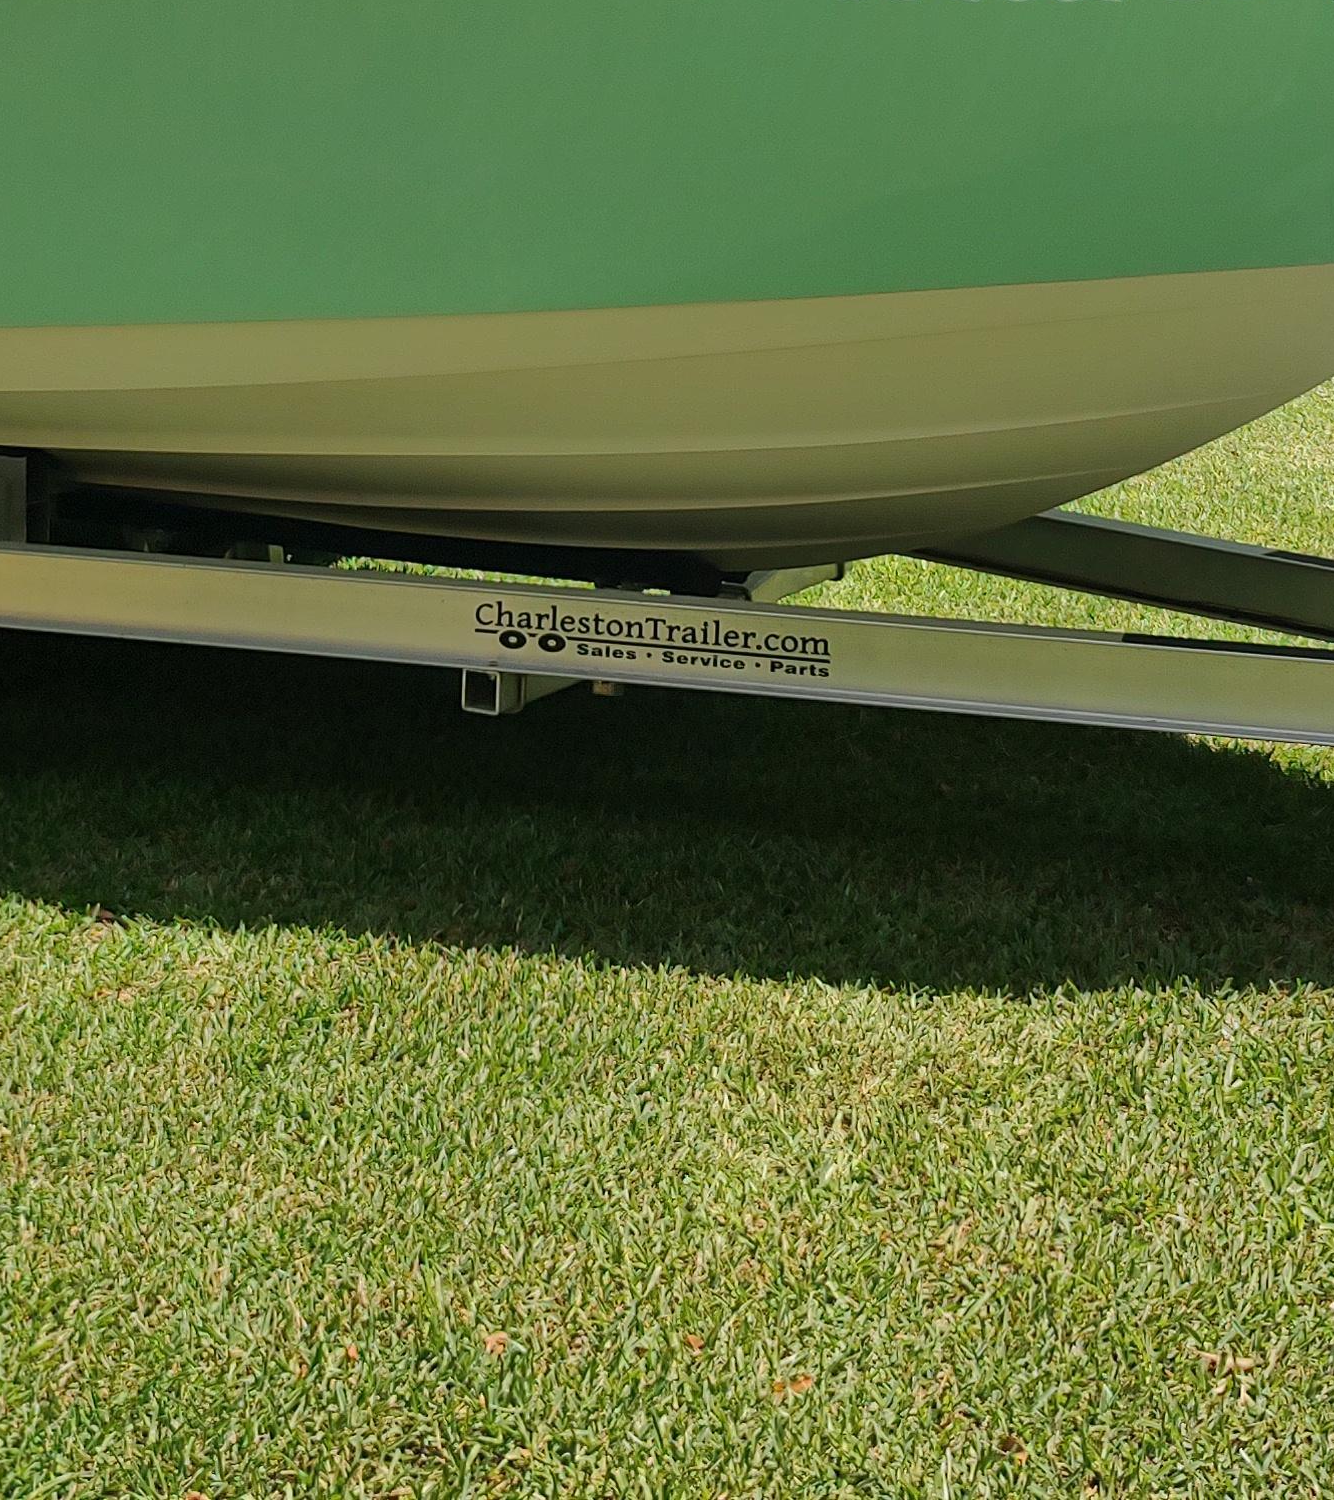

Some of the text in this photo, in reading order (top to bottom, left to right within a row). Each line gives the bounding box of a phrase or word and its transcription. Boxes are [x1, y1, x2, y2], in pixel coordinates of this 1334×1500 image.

[475, 601, 830, 656] CharlestonTrailer.com
[576, 642, 830, 678] Sales Service Parts
